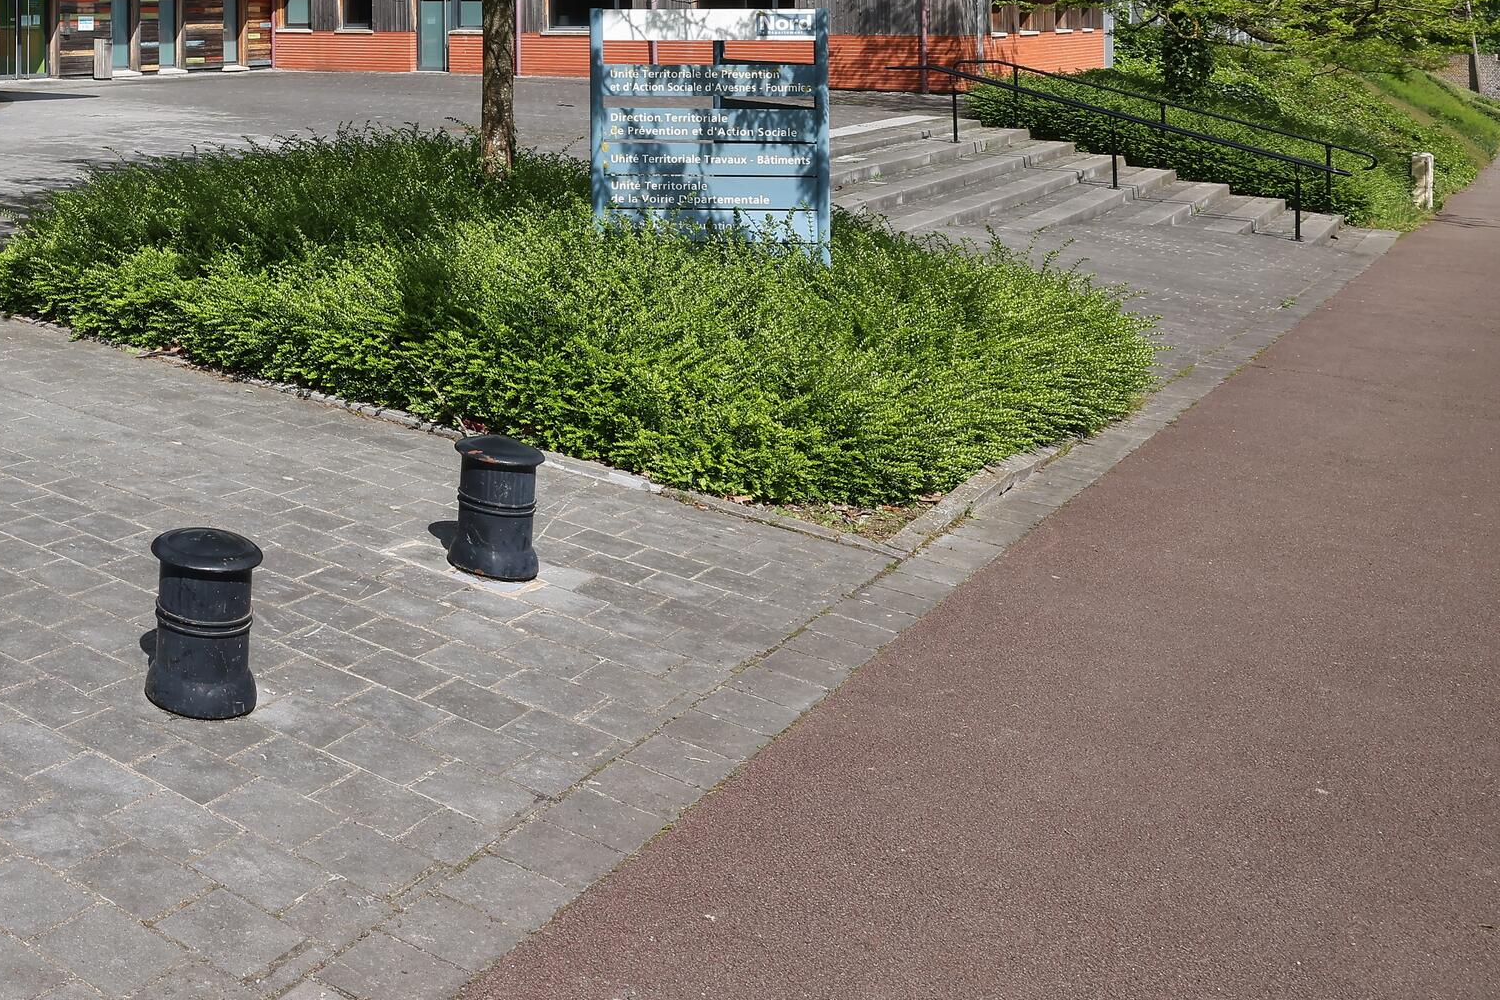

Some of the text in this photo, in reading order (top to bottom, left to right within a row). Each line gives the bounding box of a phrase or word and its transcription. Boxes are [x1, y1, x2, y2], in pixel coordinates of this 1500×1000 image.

[759, 14, 812, 31] Nord
[610, 69, 780, 79] Unité Territoriale de Prévention
[610, 84, 621, 92] et
[623, 82, 665, 92] d'Action
[667, 82, 702, 92] Sociale
[705, 83, 757, 92] d'Avesnes
[610, 112, 728, 123] Direction Territoriale
[627, 126, 688, 136] Prévention
[692, 128, 703, 136] et
[707, 127, 754, 136] d'Action
[758, 127, 798, 137] Sociale
[611, 154, 639, 164] Unité
[642, 154, 701, 164] Territoriale
[704, 155, 747, 165] Travaux
[757, 155, 811, 165] Bâtiments
[611, 181, 708, 191] Unité Territoriale
[611, 194, 770, 205] de la Voirie Départementale
